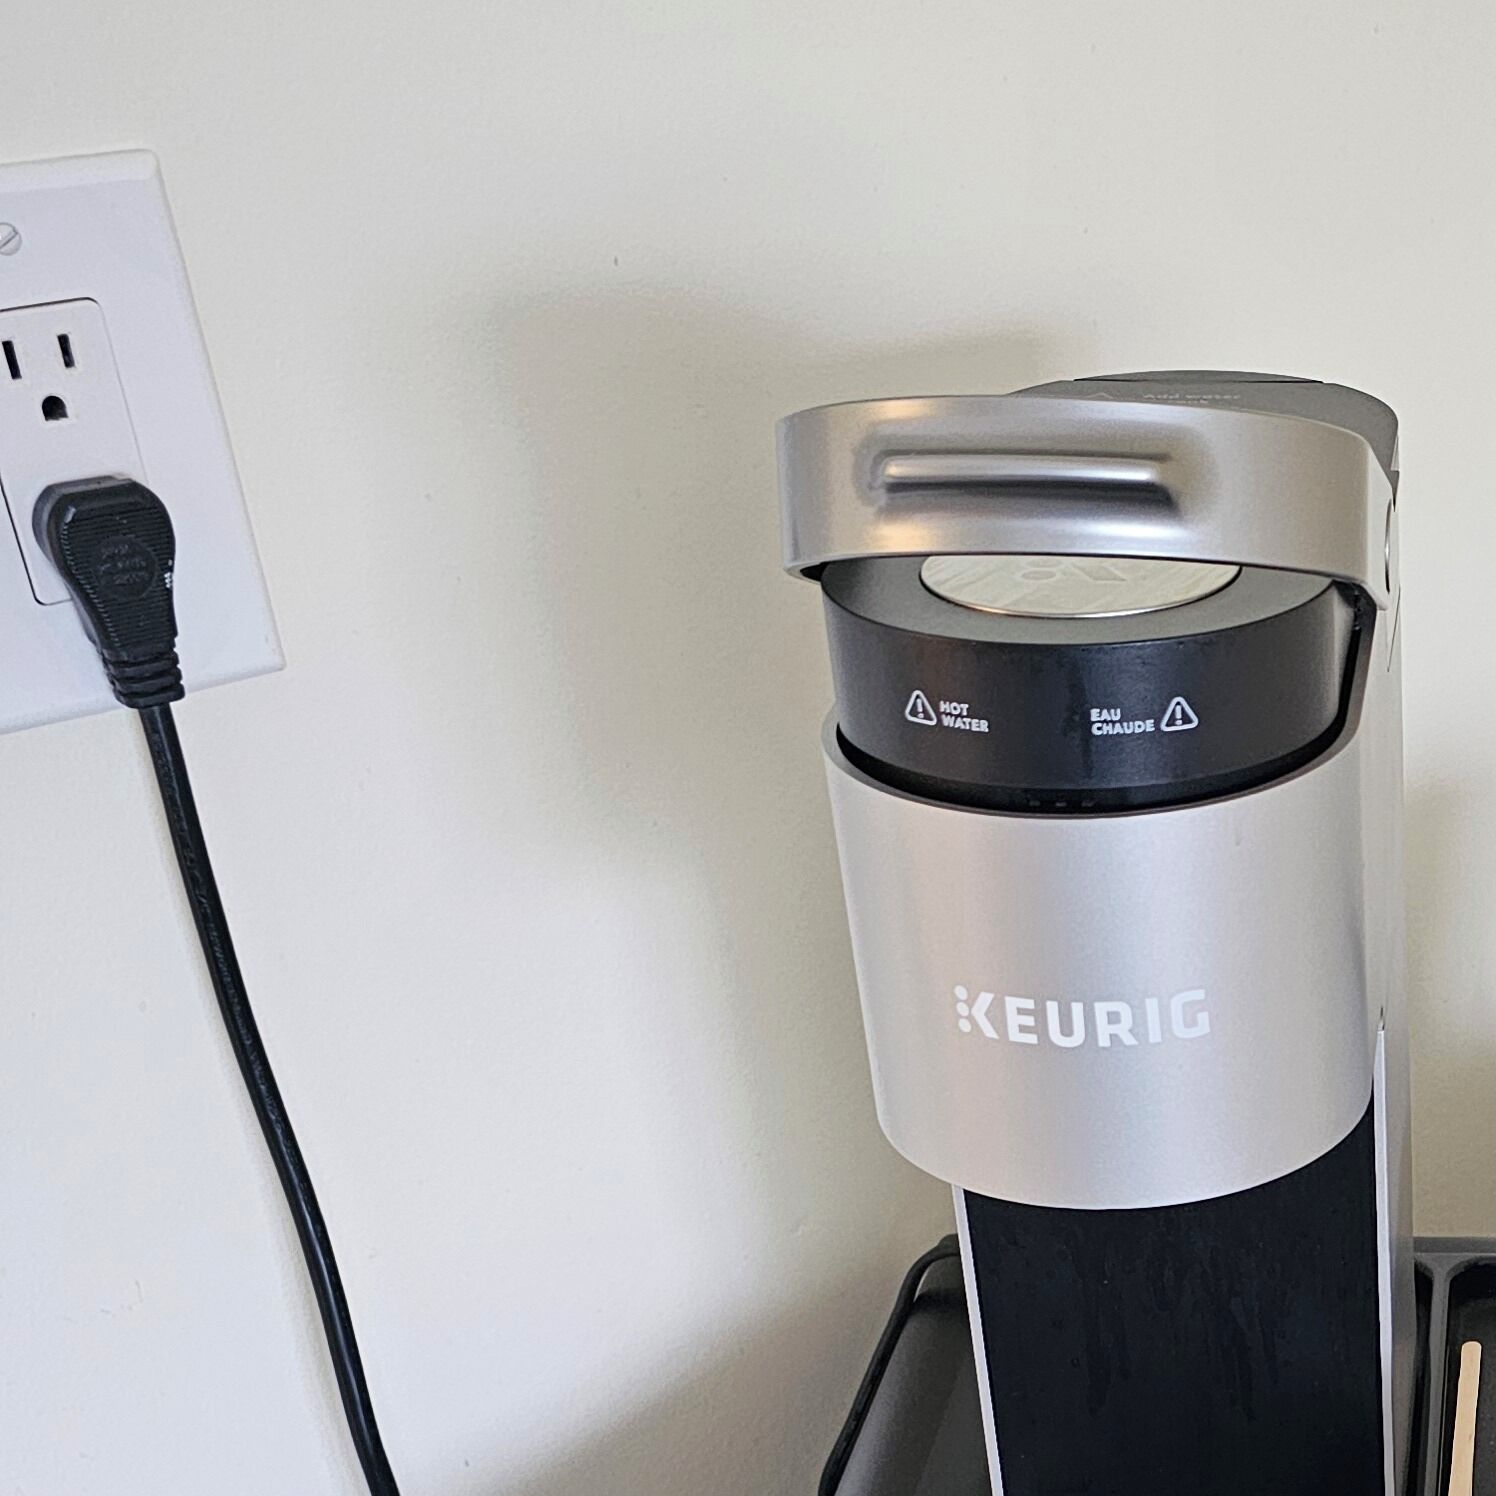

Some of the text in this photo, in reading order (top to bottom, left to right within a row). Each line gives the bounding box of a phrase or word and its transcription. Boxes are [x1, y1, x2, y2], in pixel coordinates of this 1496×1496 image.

[939, 700, 968, 716] HOT
[1090, 708, 1121, 722] EAU
[941, 714, 989, 733] WATER
[1091, 719, 1155, 735] CHAUDE
[954, 985, 1211, 1048] KEURIG
